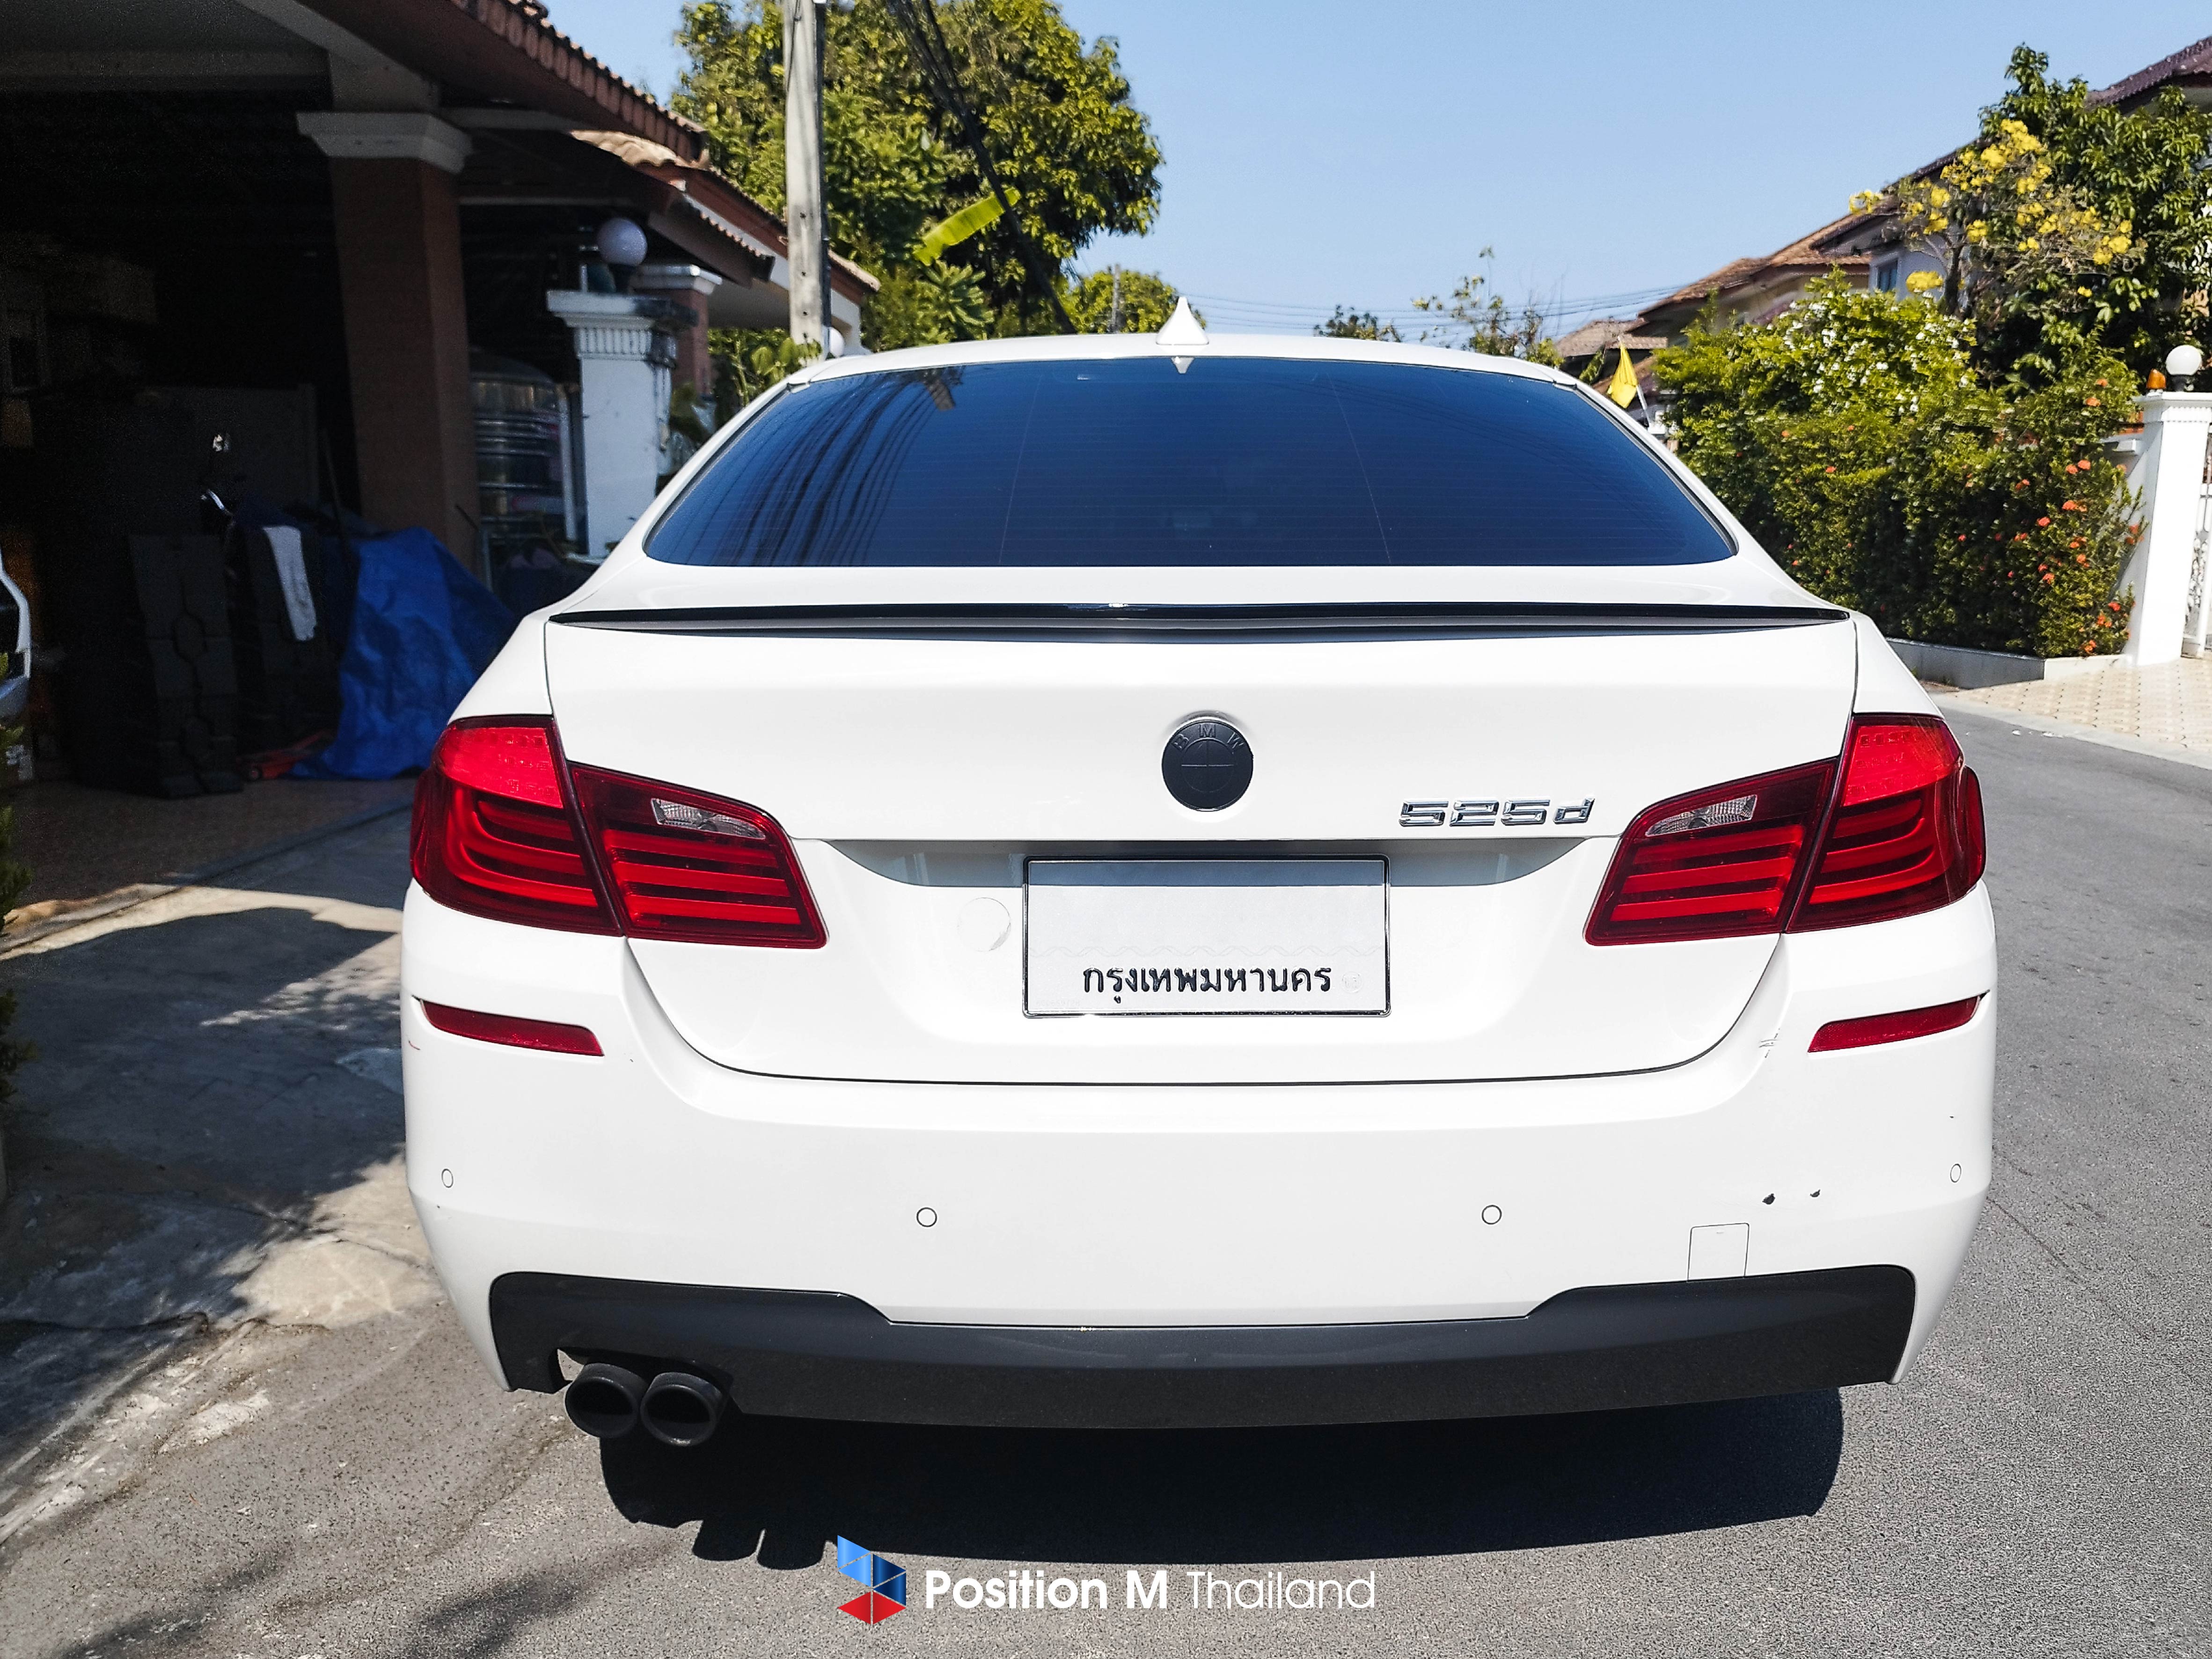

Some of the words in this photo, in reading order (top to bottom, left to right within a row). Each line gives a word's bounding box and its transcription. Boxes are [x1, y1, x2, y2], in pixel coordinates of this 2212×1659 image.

[1171, 724, 1245, 750] BMW
[1399, 798, 1596, 828] 525d
[1083, 967, 1332, 1003] กรุงเทพมหานคร
